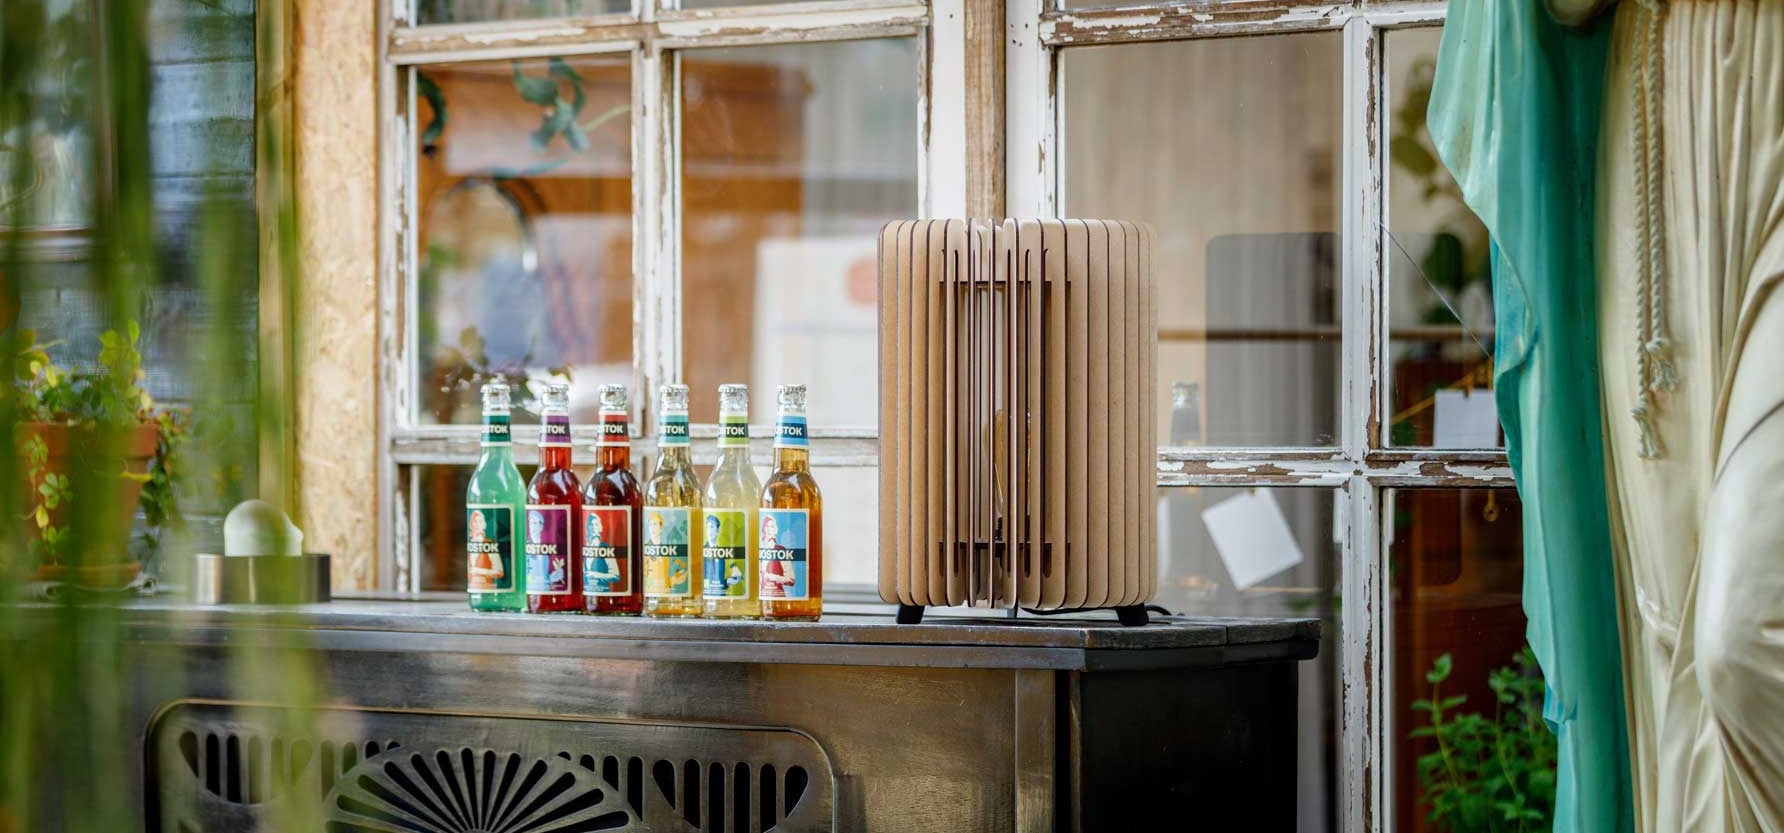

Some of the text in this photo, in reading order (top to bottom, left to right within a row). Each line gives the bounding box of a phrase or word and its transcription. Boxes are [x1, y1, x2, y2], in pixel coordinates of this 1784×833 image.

[467, 542, 499, 553] OSTOK
[526, 544, 558, 554] OSTOK
[582, 547, 615, 557] OSTOK
[645, 545, 678, 556] OSTOK
[703, 548, 734, 558] OSTOK
[759, 550, 794, 560] OSTOK
